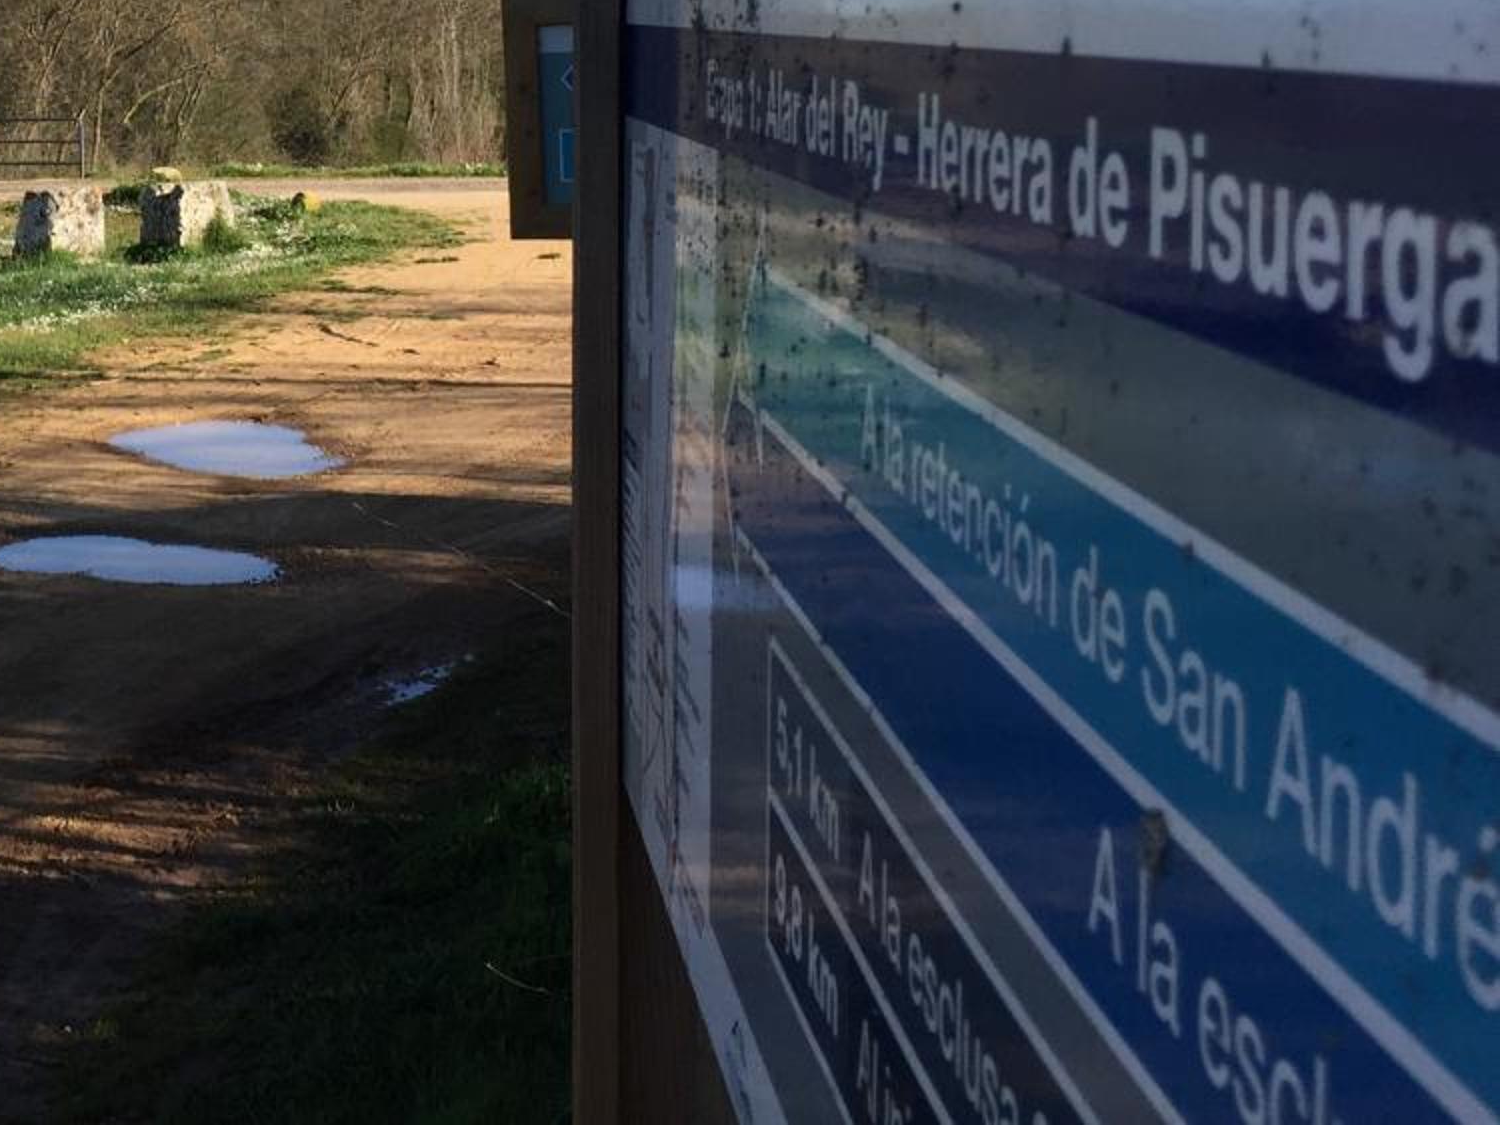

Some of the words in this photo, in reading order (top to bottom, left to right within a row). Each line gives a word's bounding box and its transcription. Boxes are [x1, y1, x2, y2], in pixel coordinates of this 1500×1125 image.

[765, 69, 801, 146] Alar
[806, 75, 836, 156] del
[843, 79, 888, 191] Rey
[917, 90, 1052, 225] Herrera
[1069, 116, 1130, 249] de
[1150, 126, 1500, 382] Pisuerga
[860, 383, 878, 473] A
[883, 395, 904, 496] la
[910, 441, 1057, 628] retención
[1070, 542, 1127, 683] de
[1140, 586, 1246, 793] San
[774, 853, 803, 960] 9,8
[808, 912, 839, 1036] km
[776, 697, 803, 796] 5,1
[809, 744, 839, 860] km
[858, 831, 876, 926] A
[881, 858, 901, 975] la
[1088, 826, 1123, 967] A
[1136, 860, 1181, 1039] la
